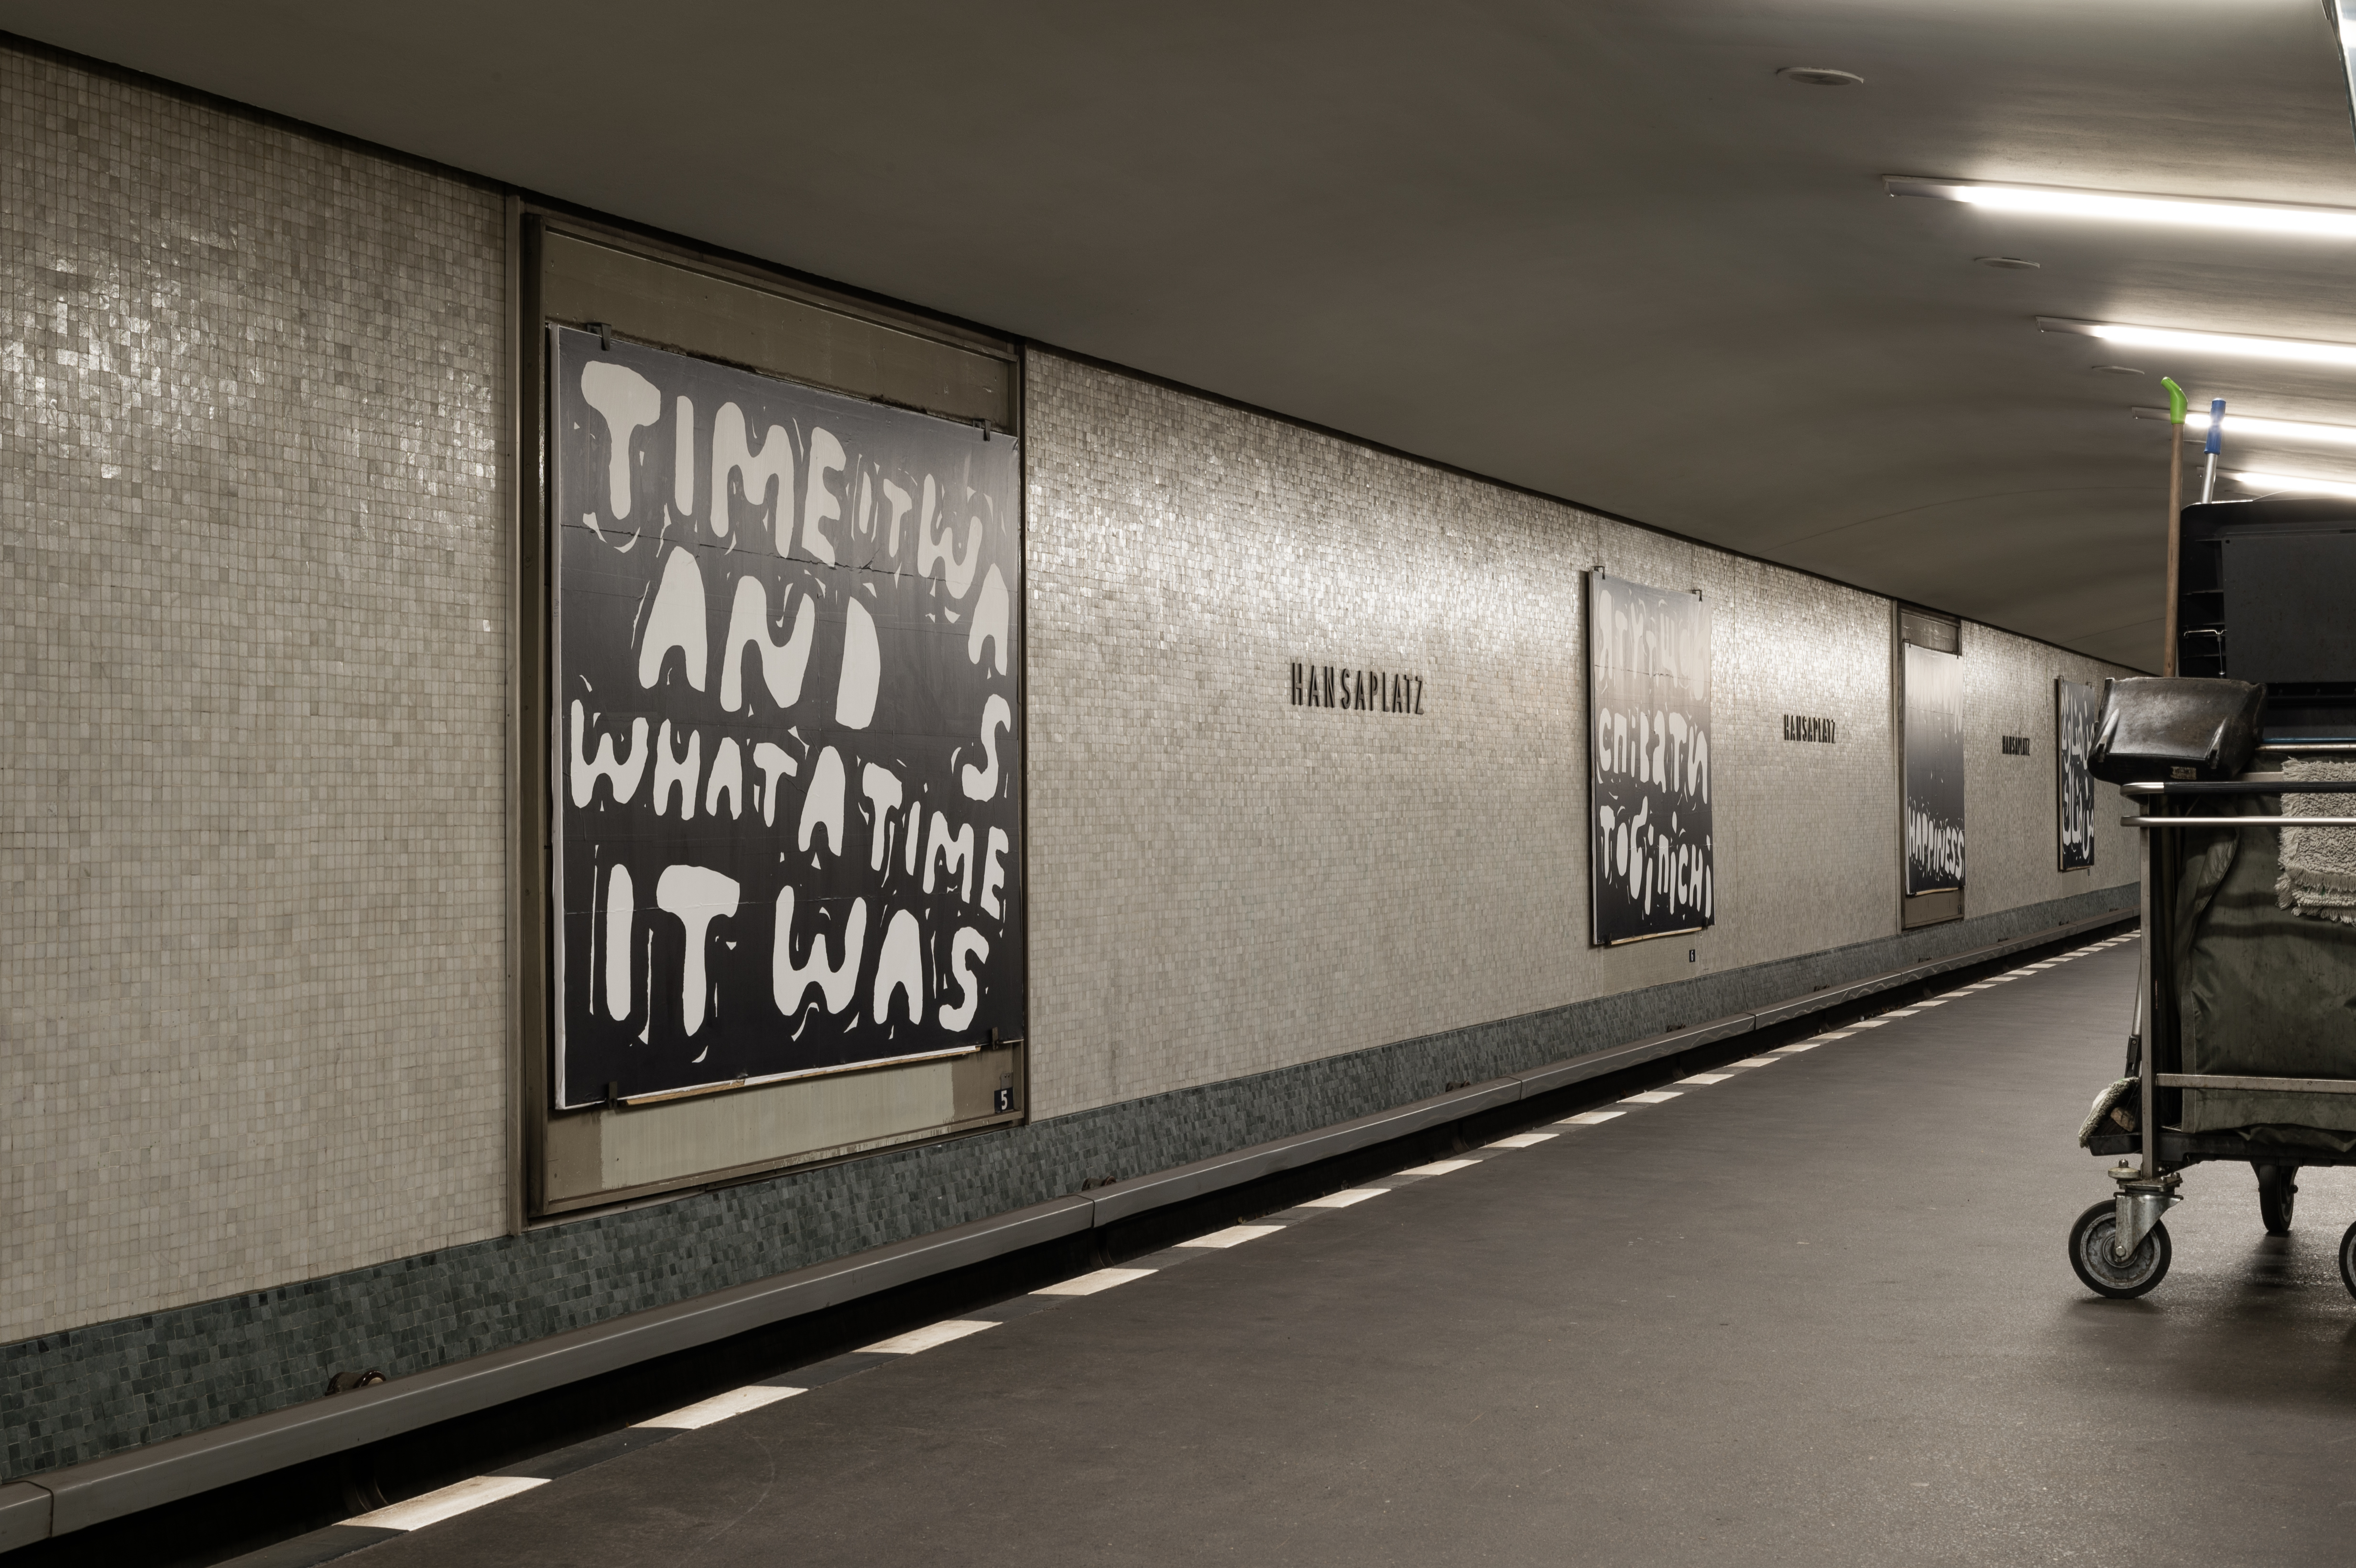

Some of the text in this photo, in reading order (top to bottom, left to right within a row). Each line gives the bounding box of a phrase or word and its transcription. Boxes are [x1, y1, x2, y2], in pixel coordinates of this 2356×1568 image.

[580, 360, 846, 568] TIME
[638, 545, 881, 730] AND
[1292, 662, 1424, 715] HANSAPLATZ
[1784, 714, 1836, 744] HANSAPLATZ
[2002, 735, 2030, 756] HANSAPLATZ
[570, 699, 1009, 919] WHAT A TIME
[1909, 805, 1964, 880] HAPPINESS
[606, 864, 989, 1036] IT WAS
[1691, 950, 1694, 961] 6
[1001, 1090, 1007, 1110] 5
